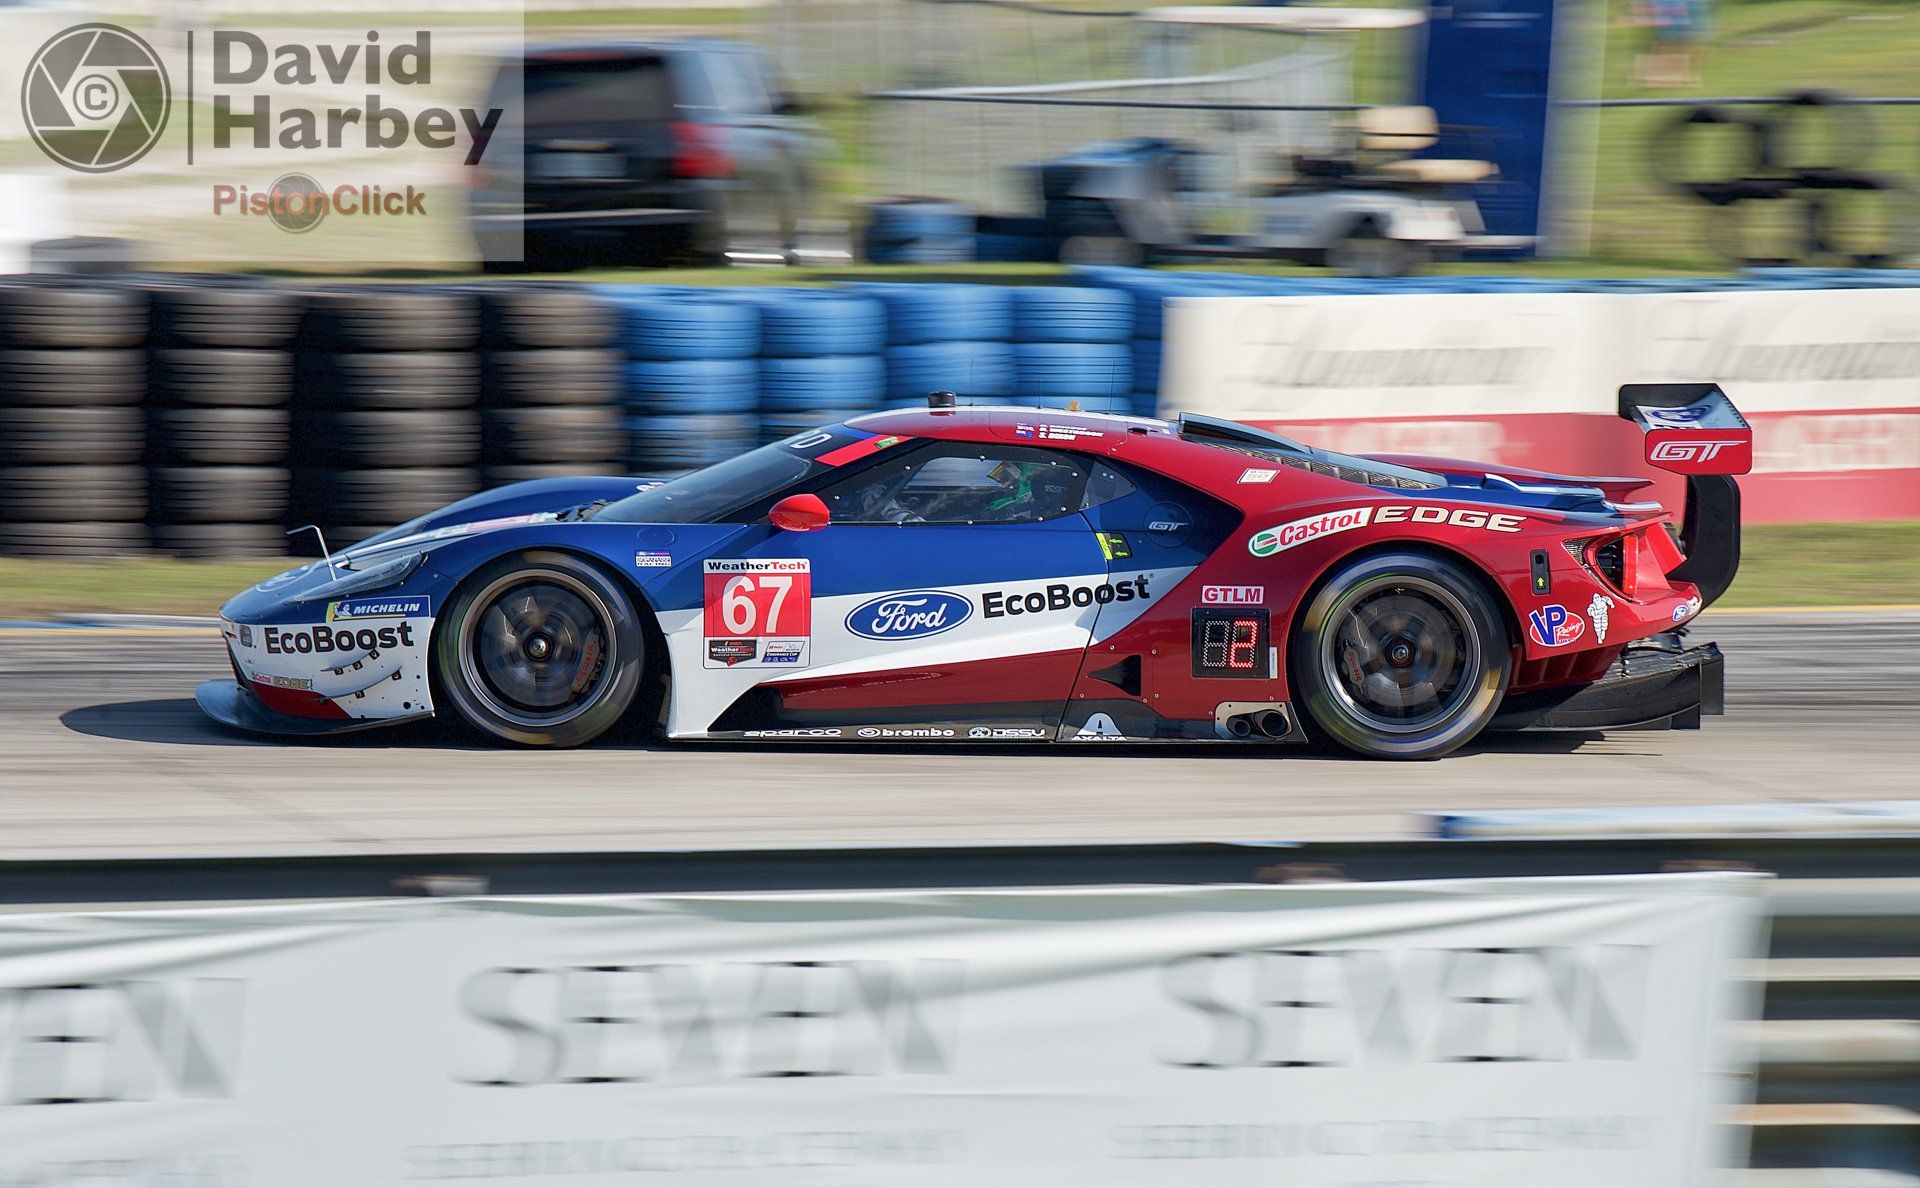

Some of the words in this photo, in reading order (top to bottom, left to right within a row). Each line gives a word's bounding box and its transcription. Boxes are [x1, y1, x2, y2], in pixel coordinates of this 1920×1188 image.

[1650, 440, 1748, 463] GT
[1148, 521, 1189, 532] GT
[1279, 510, 1362, 546] Castrol
[1373, 505, 1527, 533] EDGE
[708, 561, 806, 571] WeatherTech
[353, 603, 420, 614] MICHELIN
[722, 576, 793, 635] 67
[981, 573, 1150, 619] EcoBoost
[1204, 588, 1261, 602] GTLM
[871, 598, 947, 634] Ford
[1529, 604, 1568, 646] VP
[264, 621, 414, 654] EcoBoost
[743, 728, 842, 738] sparco
[882, 727, 955, 738] brembo
[1157, 944, 1653, 1068] SEVEN
[453, 960, 969, 1087] SEVEN
